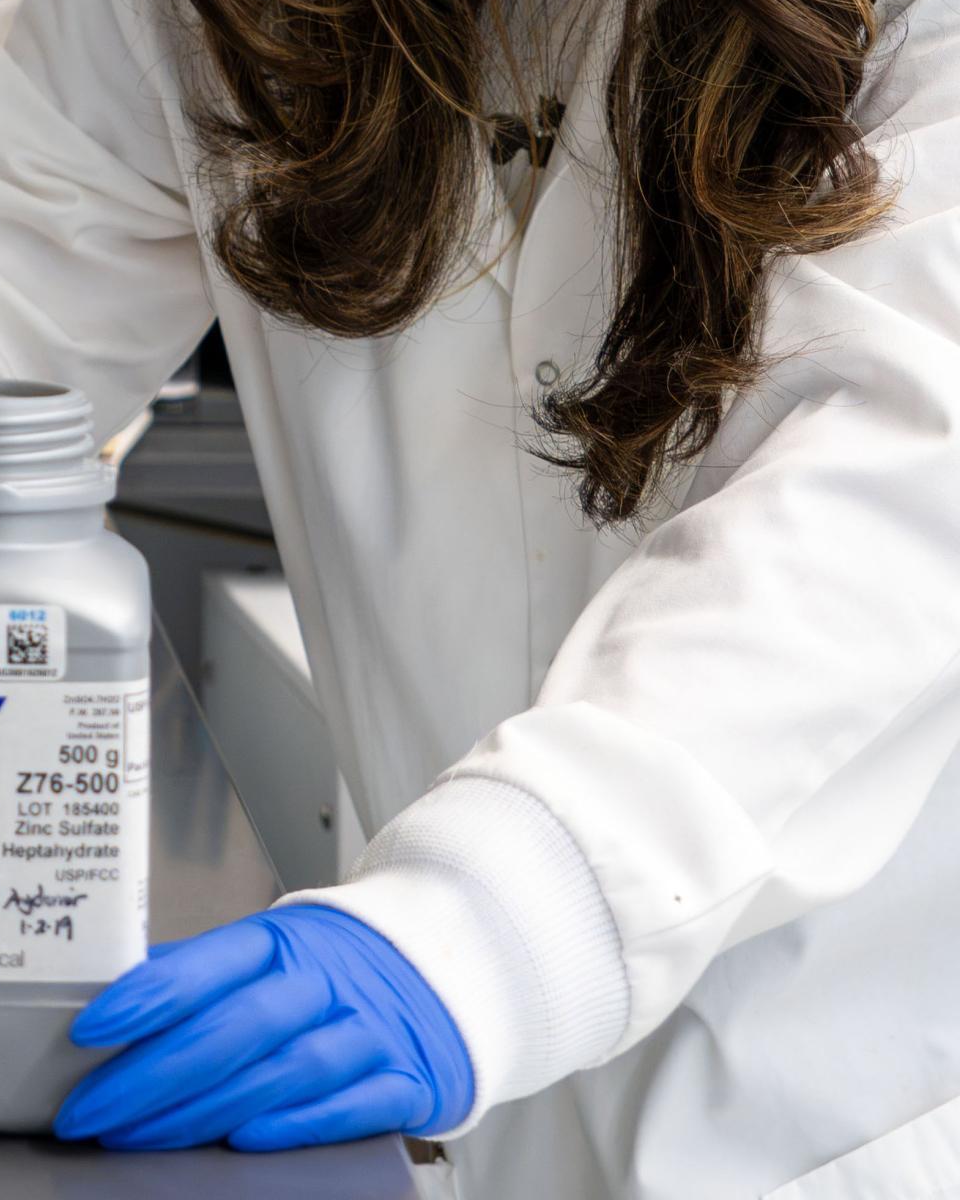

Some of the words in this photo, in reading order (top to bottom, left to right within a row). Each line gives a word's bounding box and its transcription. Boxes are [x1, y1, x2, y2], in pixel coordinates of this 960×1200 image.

[58, 745, 98, 765] 500
[105, 749, 120, 769] g
[15, 771, 120, 795] Z76-500
[17, 802, 52, 816] LOT
[62, 802, 120, 816] 185400
[14, 820, 53, 836] Zinc
[58, 820, 120, 836] Sulfate
[1, 843, 120, 862] Heptahydrate
[54, 868, 120, 881] USP/FCC
